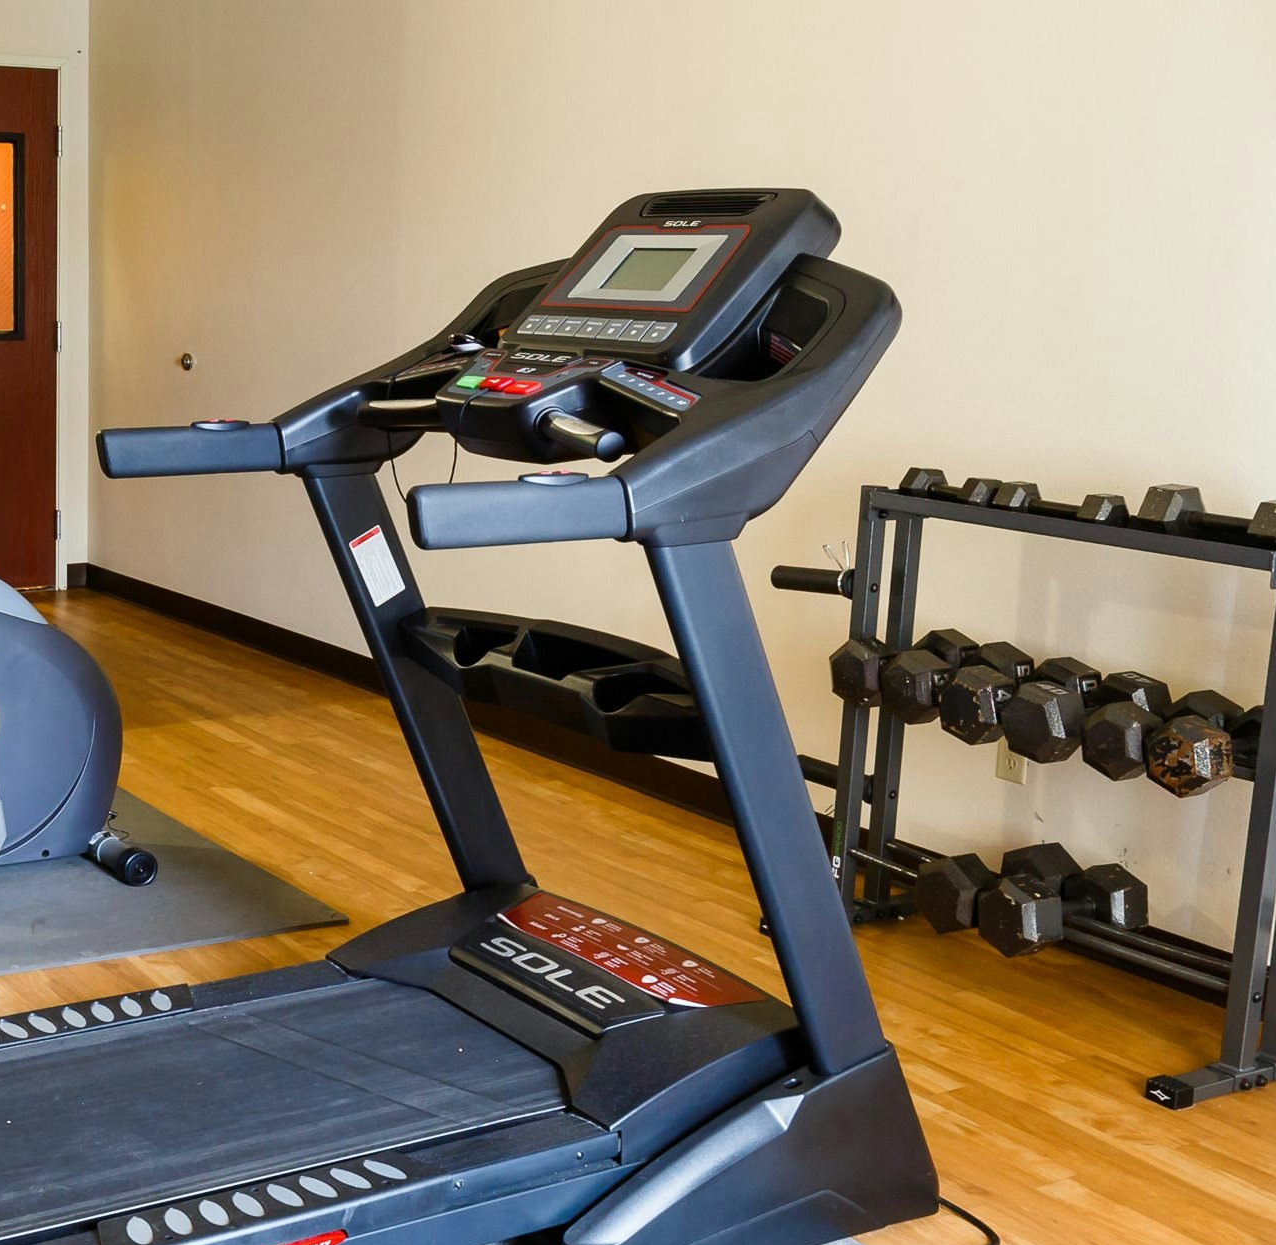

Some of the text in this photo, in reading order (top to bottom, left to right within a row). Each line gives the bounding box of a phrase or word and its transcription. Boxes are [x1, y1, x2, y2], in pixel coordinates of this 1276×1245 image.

[663, 220, 702, 228] SOLE
[510, 352, 572, 363] SOLE
[480, 936, 626, 1010] SOLE
